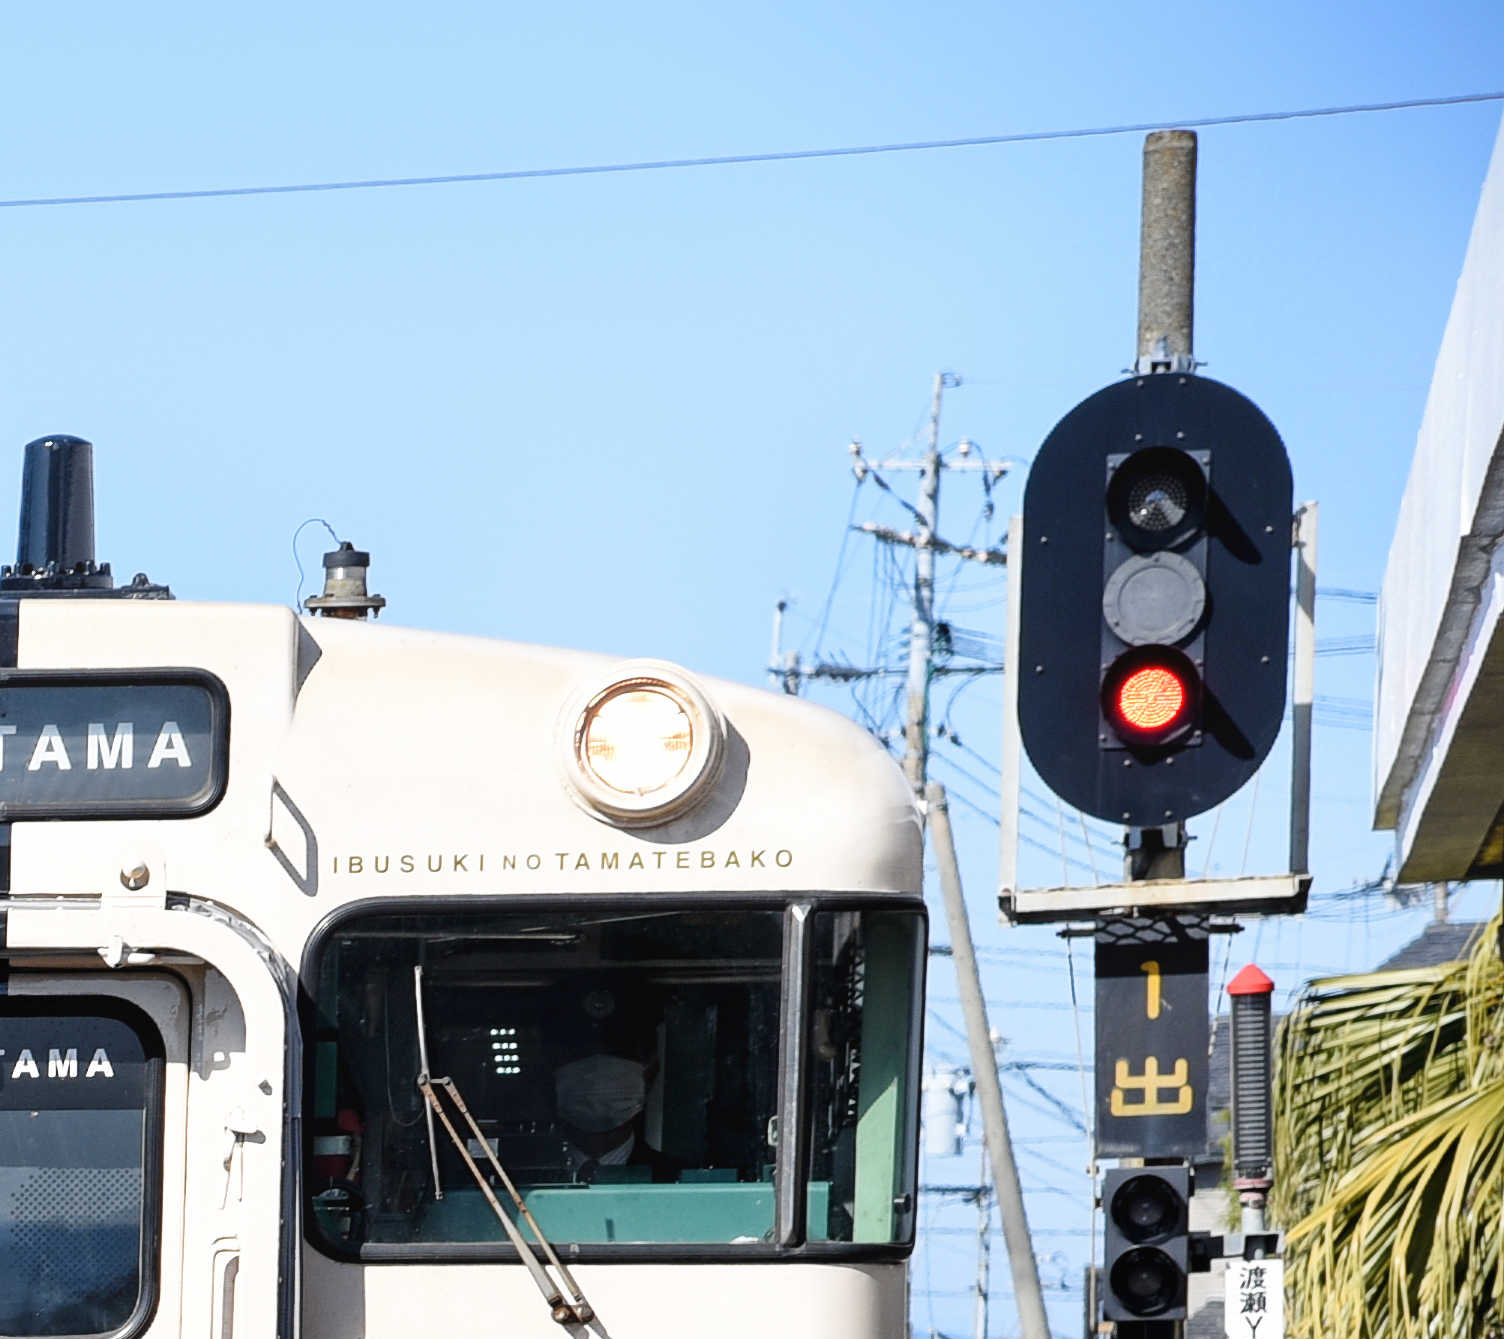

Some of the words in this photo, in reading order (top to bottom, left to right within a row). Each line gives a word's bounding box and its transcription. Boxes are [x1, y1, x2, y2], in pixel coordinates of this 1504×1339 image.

[333, 852, 485, 874] IBUSUKI
[502, 854, 541, 871] NO
[554, 848, 795, 872] TAMATEBAKO
